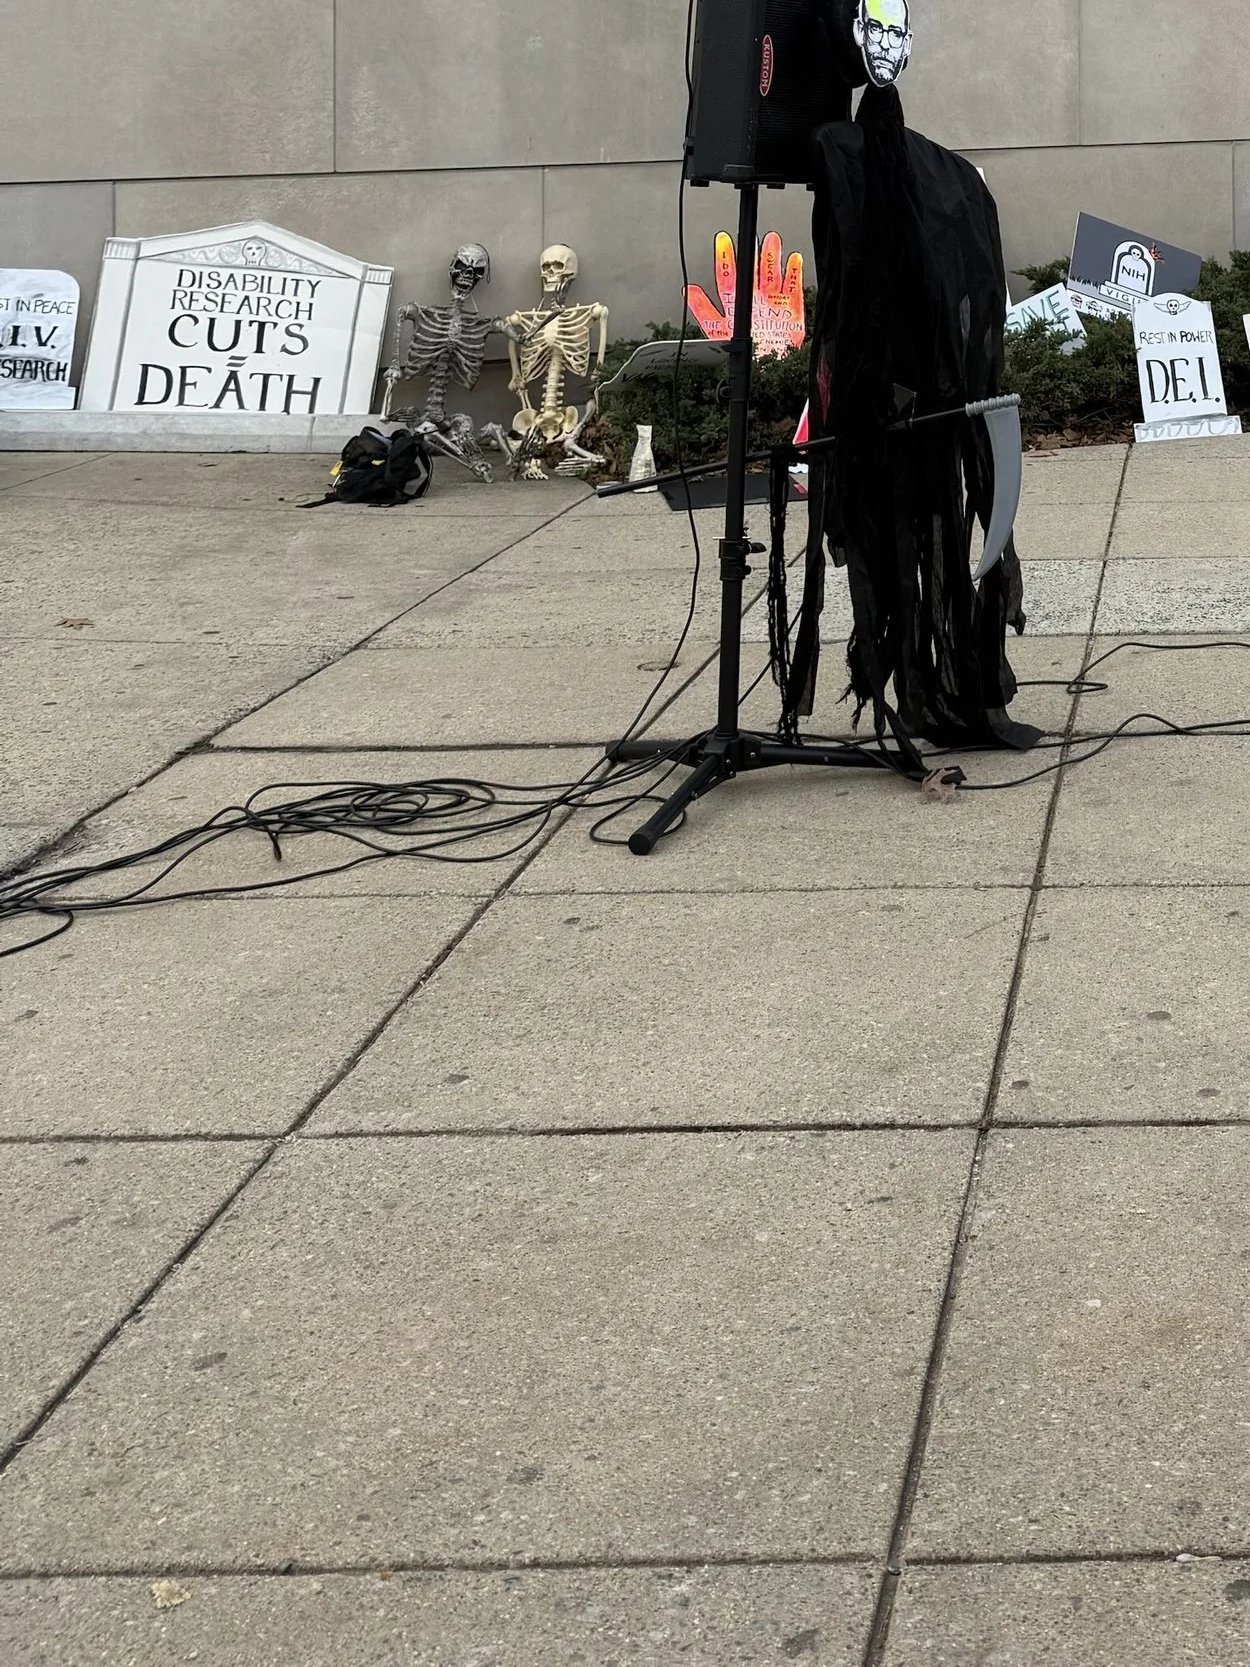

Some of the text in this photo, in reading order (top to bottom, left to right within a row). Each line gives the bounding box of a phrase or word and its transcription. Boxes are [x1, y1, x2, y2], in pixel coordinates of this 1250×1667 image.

[761, 43, 771, 87] KUSTOM
[176, 268, 322, 299] DISABILITY
[722, 263, 730, 277] DO
[788, 267, 798, 293] THAT
[1121, 265, 1147, 282] NIH
[16, 299, 31, 312] IN
[33, 298, 77, 315] PEACE
[169, 288, 314, 321] RESEARCH
[1005, 289, 1070, 334] SAVE
[167, 313, 310, 356] CUTS
[704, 320, 721, 329] THE
[1139, 330, 1214, 345] REST IN POWER
[0, 358, 69, 382] SEARCH
[1145, 356, 1221, 405] D.E.I.
[133, 363, 324, 416] DEATH
